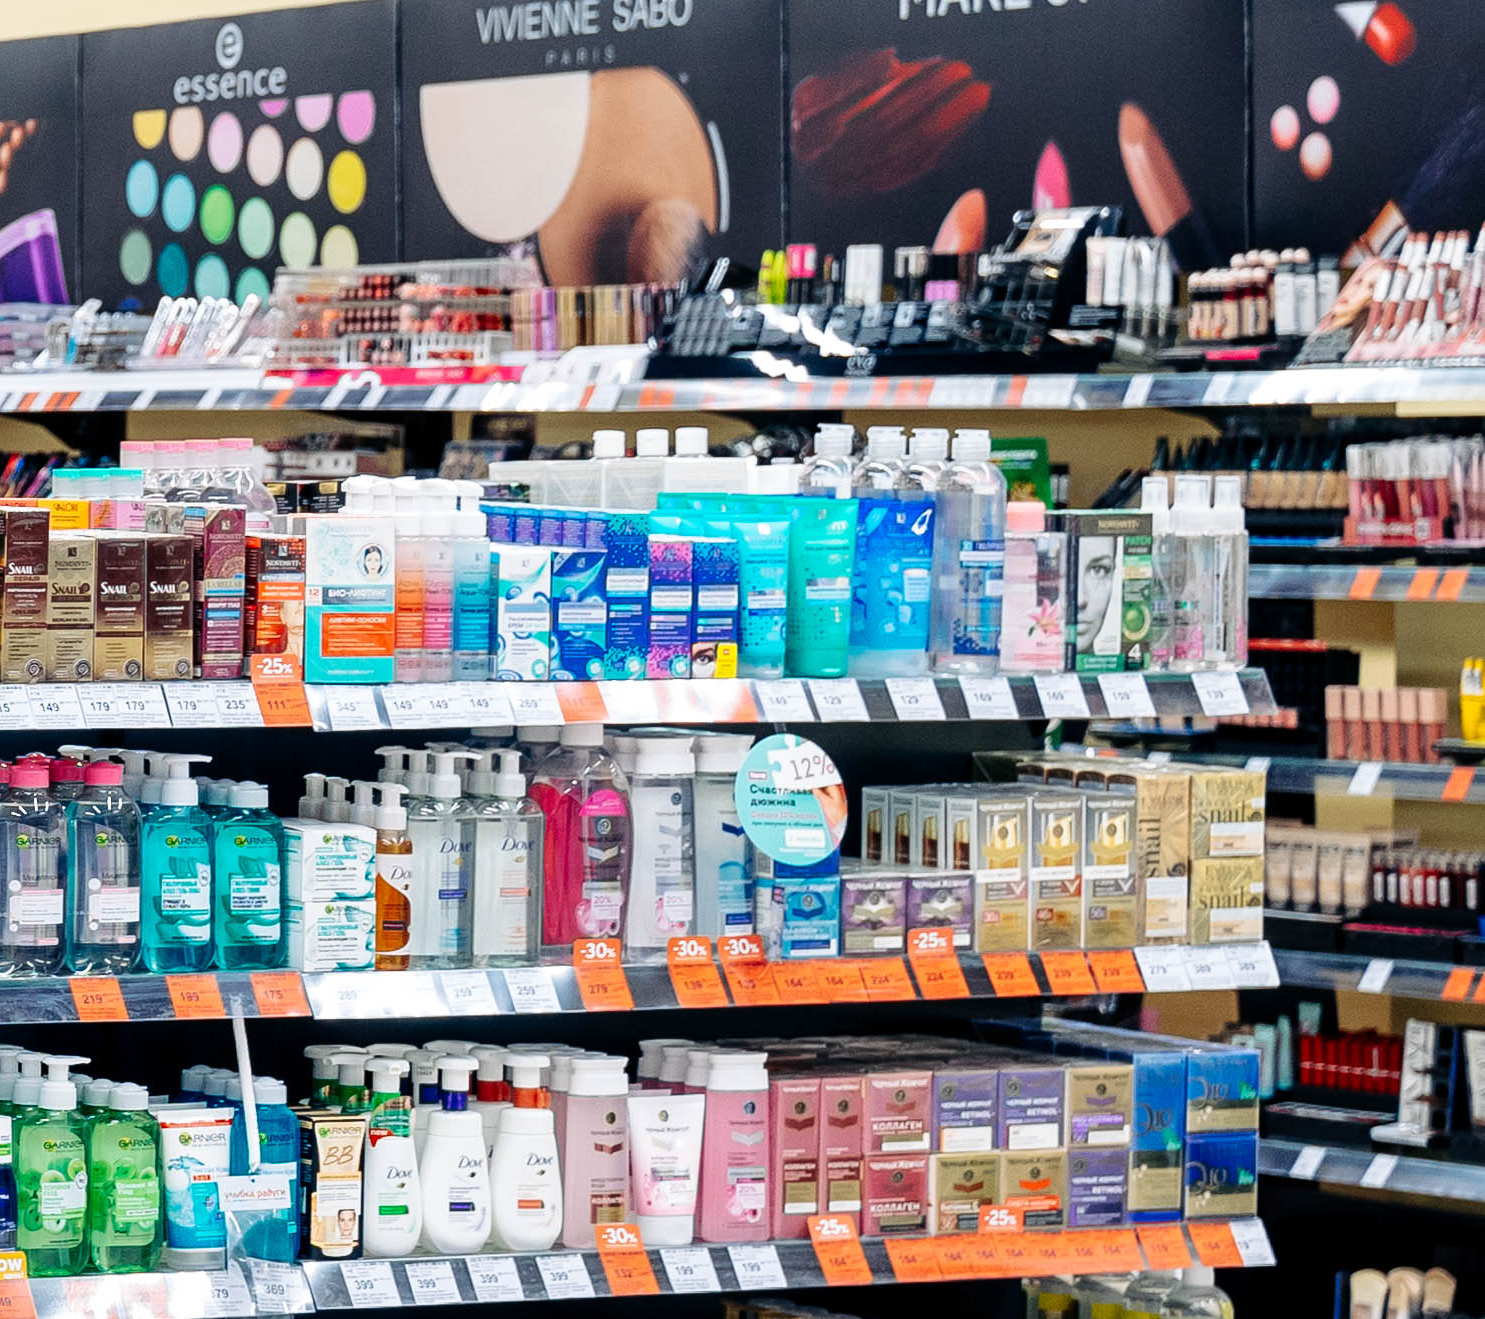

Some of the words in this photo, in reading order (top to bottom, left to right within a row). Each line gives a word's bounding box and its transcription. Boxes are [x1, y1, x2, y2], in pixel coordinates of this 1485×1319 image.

[476, 0, 601, 45] VIVIENNE
[546, 45, 619, 67] PARIS
[173, 66, 288, 104] essence
[256, 658, 293, 675] -25%
[790, 755, 834, 781] 12%
[580, 941, 617, 960] -30%
[600, 1228, 637, 1245] -30%
